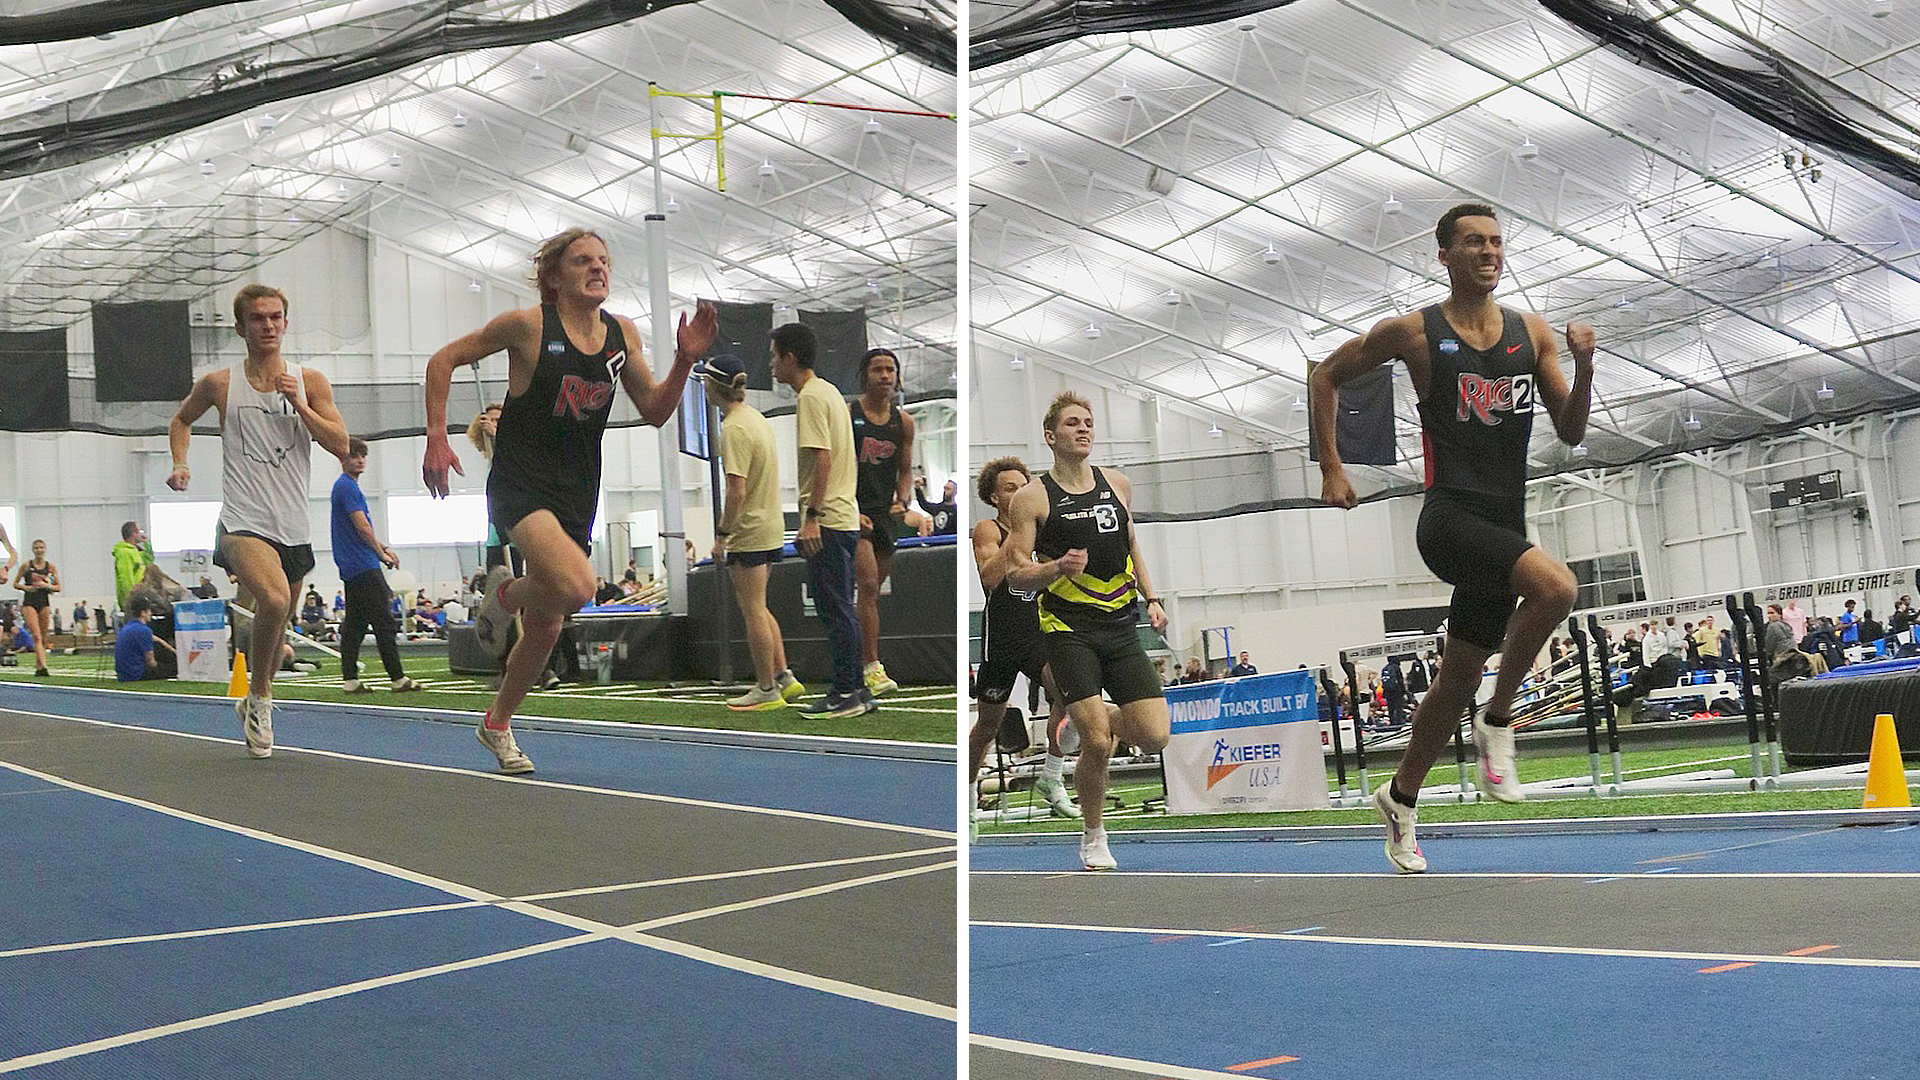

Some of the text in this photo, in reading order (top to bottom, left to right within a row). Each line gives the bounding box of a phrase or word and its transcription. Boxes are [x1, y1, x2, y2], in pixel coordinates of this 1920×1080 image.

[1513, 378, 1530, 410] 2
[1778, 584, 1813, 601] GRAND
[1817, 579, 1855, 596] VALLEY
[1857, 573, 1891, 591] STATE
[1625, 608, 1648, 620] GRAND
[1650, 604, 1674, 616] VALLEY
[1676, 601, 1697, 613] STATE
[1172, 693, 1309, 723] MONDO TRACK BUILT BY
[1229, 743, 1281, 763] KIEFER
